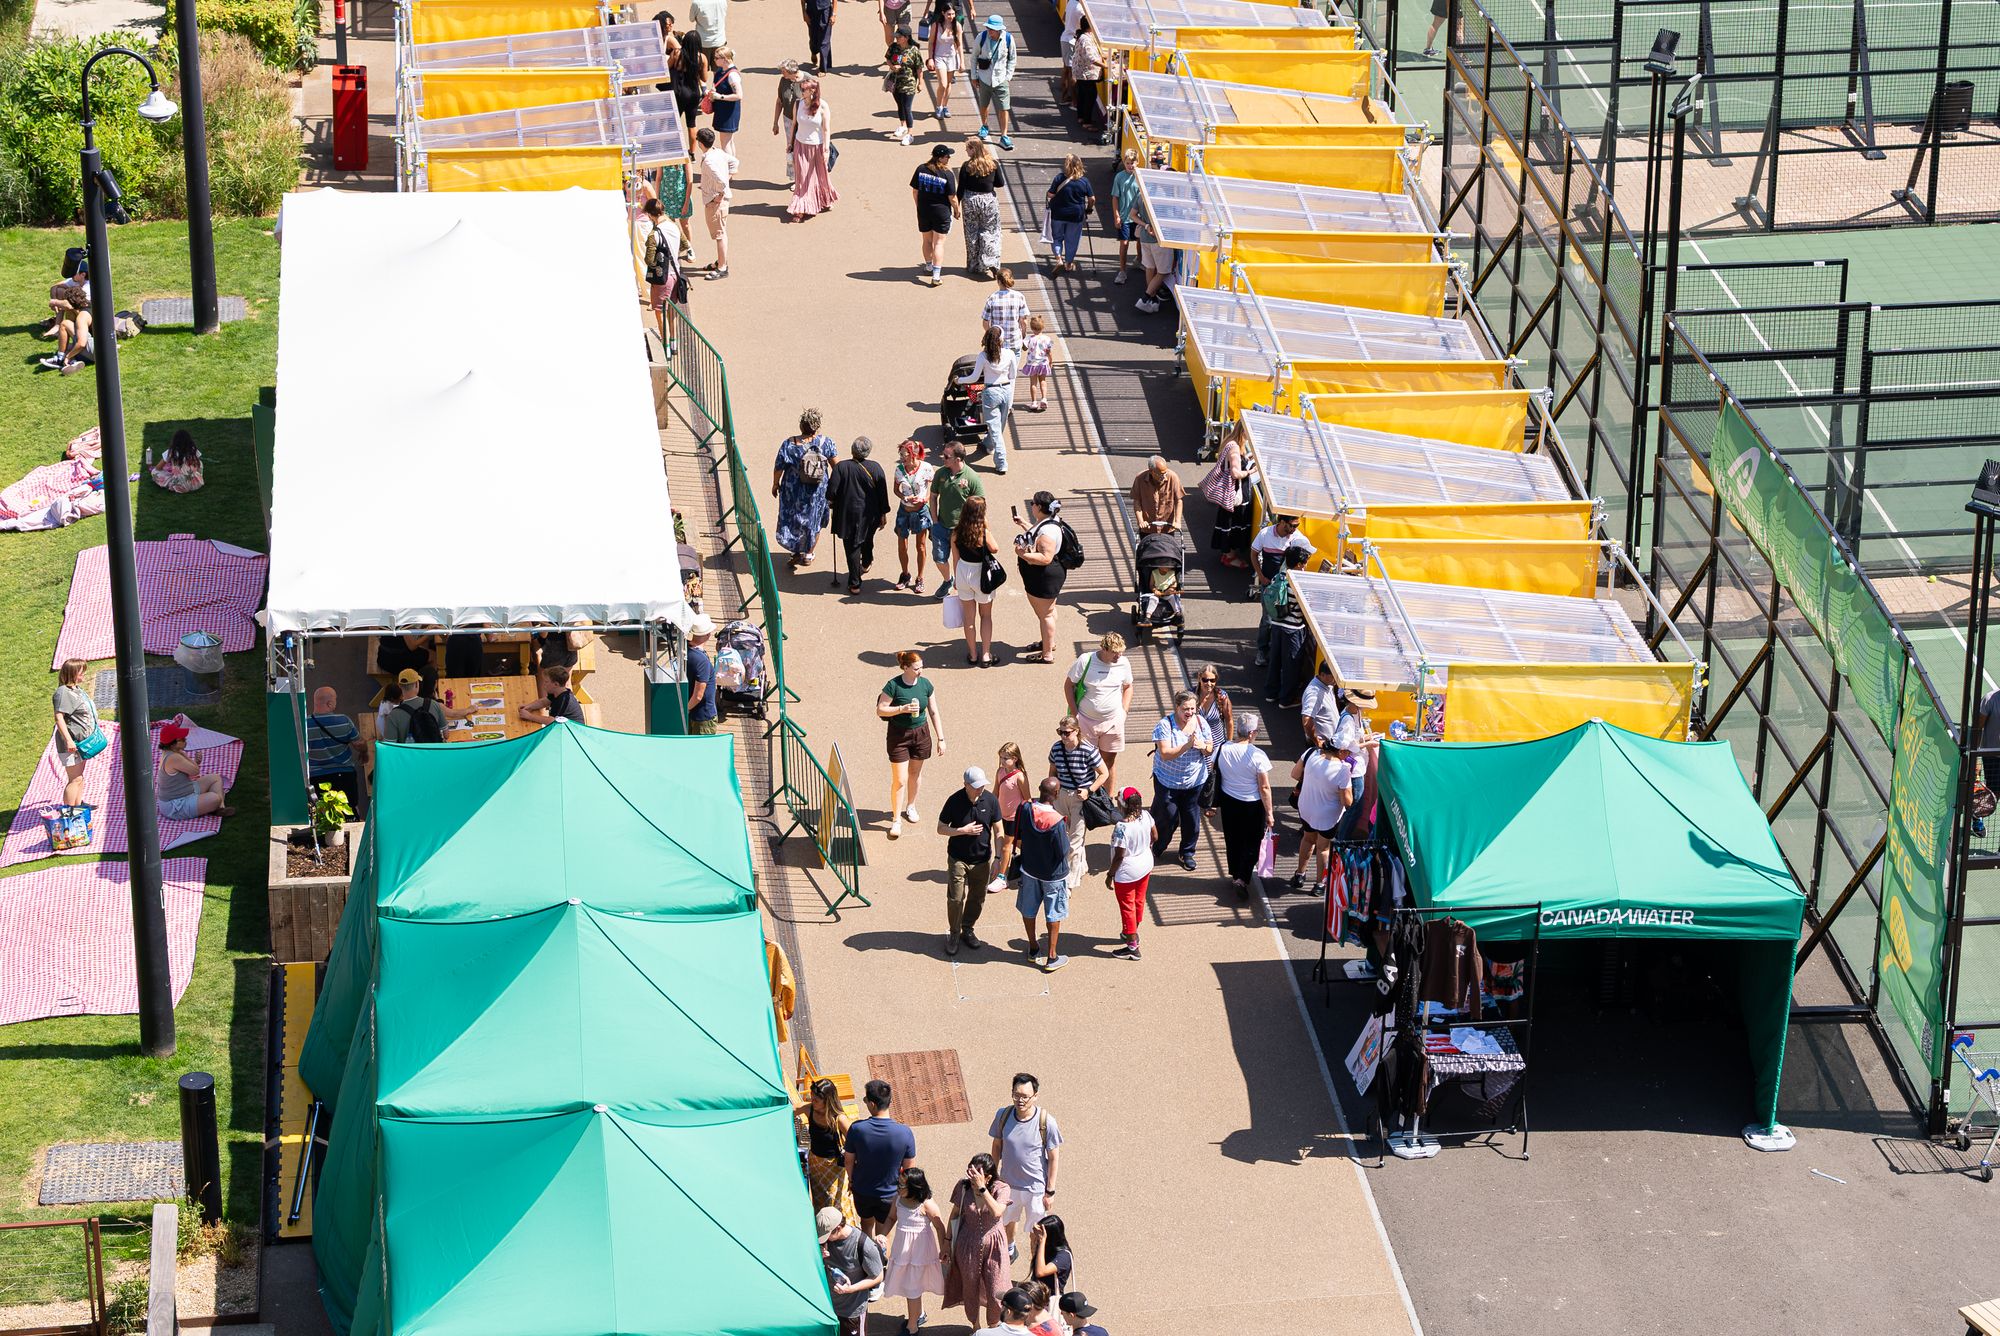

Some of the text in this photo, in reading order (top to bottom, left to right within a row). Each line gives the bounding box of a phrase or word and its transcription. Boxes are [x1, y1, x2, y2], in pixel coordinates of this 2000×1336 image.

[1888, 813, 1913, 893] ere
[1540, 908, 1695, 926] CANADA WATER
